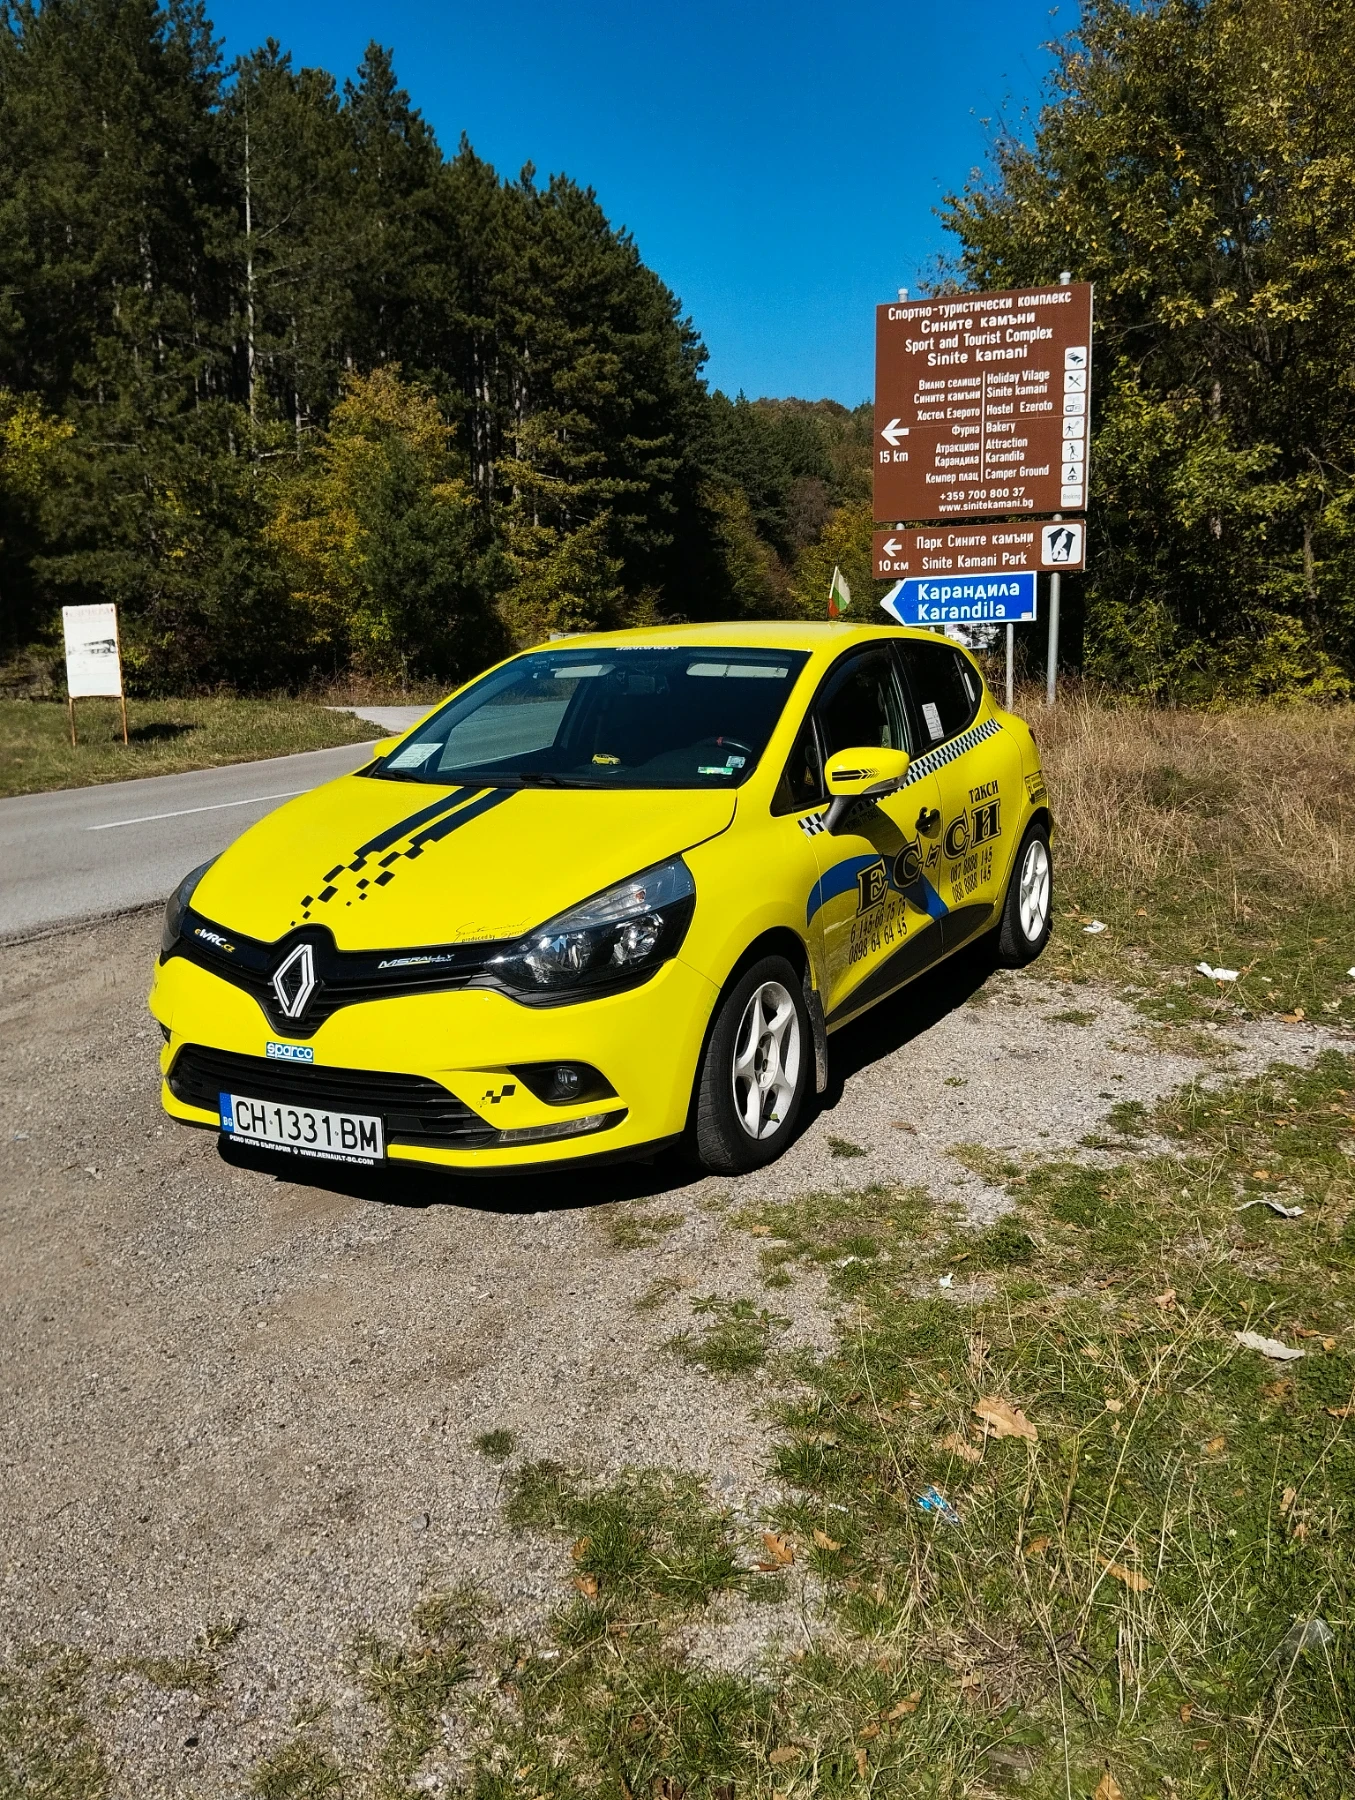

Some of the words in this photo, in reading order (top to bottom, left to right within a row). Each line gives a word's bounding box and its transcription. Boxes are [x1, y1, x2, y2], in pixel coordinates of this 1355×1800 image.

[888, 297, 1013, 321] Спортно-туристически
[1017, 291, 1072, 307] комплекс
[921, 318, 973, 334] Сините
[980, 312, 1036, 328] камъни
[905, 338, 934, 355] Sport
[939, 335, 959, 350] and
[963, 331, 1001, 347] Tourist
[1006, 326, 1053, 343] Complex
[927, 352, 968, 367] Sinite
[975, 345, 1028, 362] kamani
[918, 378, 945, 390] Вилно
[947, 376, 981, 389] селище
[987, 371, 1020, 385] Holiday
[1022, 370, 1050, 383] Vilage
[914, 392, 945, 404] Сините
[947, 390, 981, 401] камъни
[986, 386, 1012, 398] Sinite
[1015, 383, 1048, 396] kamani
[917, 410, 945, 421] Хостел
[946, 407, 980, 420] Езерото
[986, 403, 1014, 416] Hostel
[1020, 401, 1053, 412] Ezeroto
[951, 424, 980, 437] Фурна
[986, 421, 1016, 434] Bakery
[935, 442, 980, 454] Атракцион
[985, 437, 1028, 450] Attraction
[879, 451, 890, 463] 15
[893, 450, 909, 462] km
[935, 455, 980, 468] Карандила
[985, 450, 1025, 463] Karandila
[925, 472, 957, 485] Кемпер
[959, 470, 979, 482] плац
[985, 468, 1017, 480] Camper
[1019, 464, 1050, 477] Ground
[939, 491, 965, 501] +359
[968, 489, 987, 500] 700
[990, 488, 1009, 498] 800
[1012, 487, 1026, 497] 37
[938, 498, 1034, 512] www.sinitekamani.bg
[916, 536, 943, 551] Парк
[948, 534, 987, 548] Сините
[992, 532, 1034, 546] камъни
[878, 560, 891, 572] 10
[893, 561, 909, 571] км
[922, 556, 953, 570] Sinite
[957, 553, 997, 568] Kamani
[1002, 552, 1027, 566] Park
[917, 582, 1020, 603] Карандила
[917, 602, 1006, 620] Karandila
[968, 780, 999, 804] такси
[981, 845, 993, 866] 145
[980, 864, 992, 884] 145
[884, 921, 894, 945] 64
[897, 916, 907, 937] 45
[194, 928, 236, 953] eWRC.cz
[267, 1042, 313, 1059] sparco
[223, 1117, 233, 1127] BG
[235, 1100, 267, 1135] CH
[273, 1108, 332, 1147] 1331
[340, 1117, 378, 1153] BM
[300, 1148, 375, 1166] WWW.RENAULT-BG.COM
